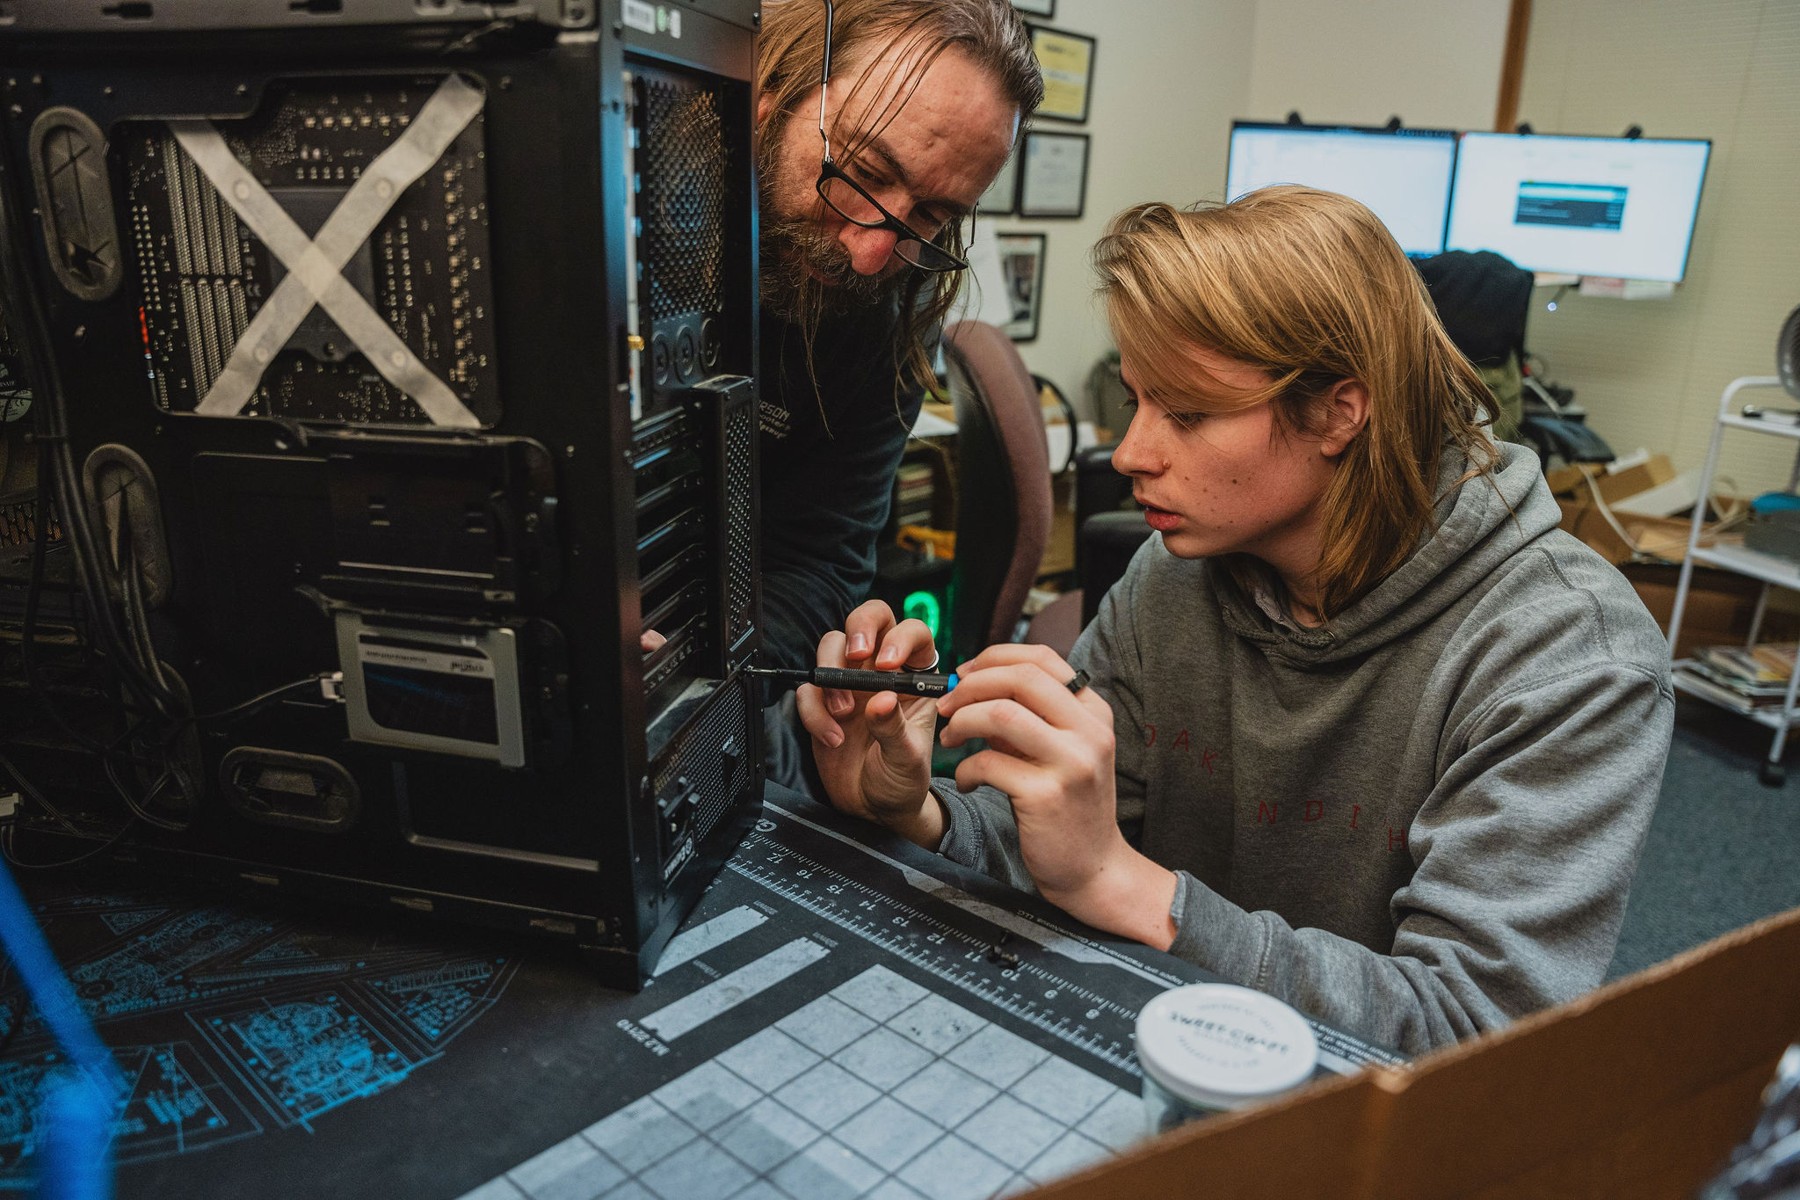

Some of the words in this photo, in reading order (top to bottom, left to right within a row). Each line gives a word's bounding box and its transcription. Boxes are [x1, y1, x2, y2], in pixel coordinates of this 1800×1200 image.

[759, 400, 790, 422] RSON
[740, 840, 755, 850] 18
[766, 852, 783, 864] 17
[796, 869, 813, 879] 16
[826, 884, 845, 896] 15
[859, 900, 877, 911] 14
[892, 916, 910, 927] 13
[926, 932, 945, 945] 12
[964, 951, 982, 963] 11
[1001, 969, 1021, 981] 10
[1043, 989, 1059, 1000] 9
[1085, 1008, 1100, 1020] 8
